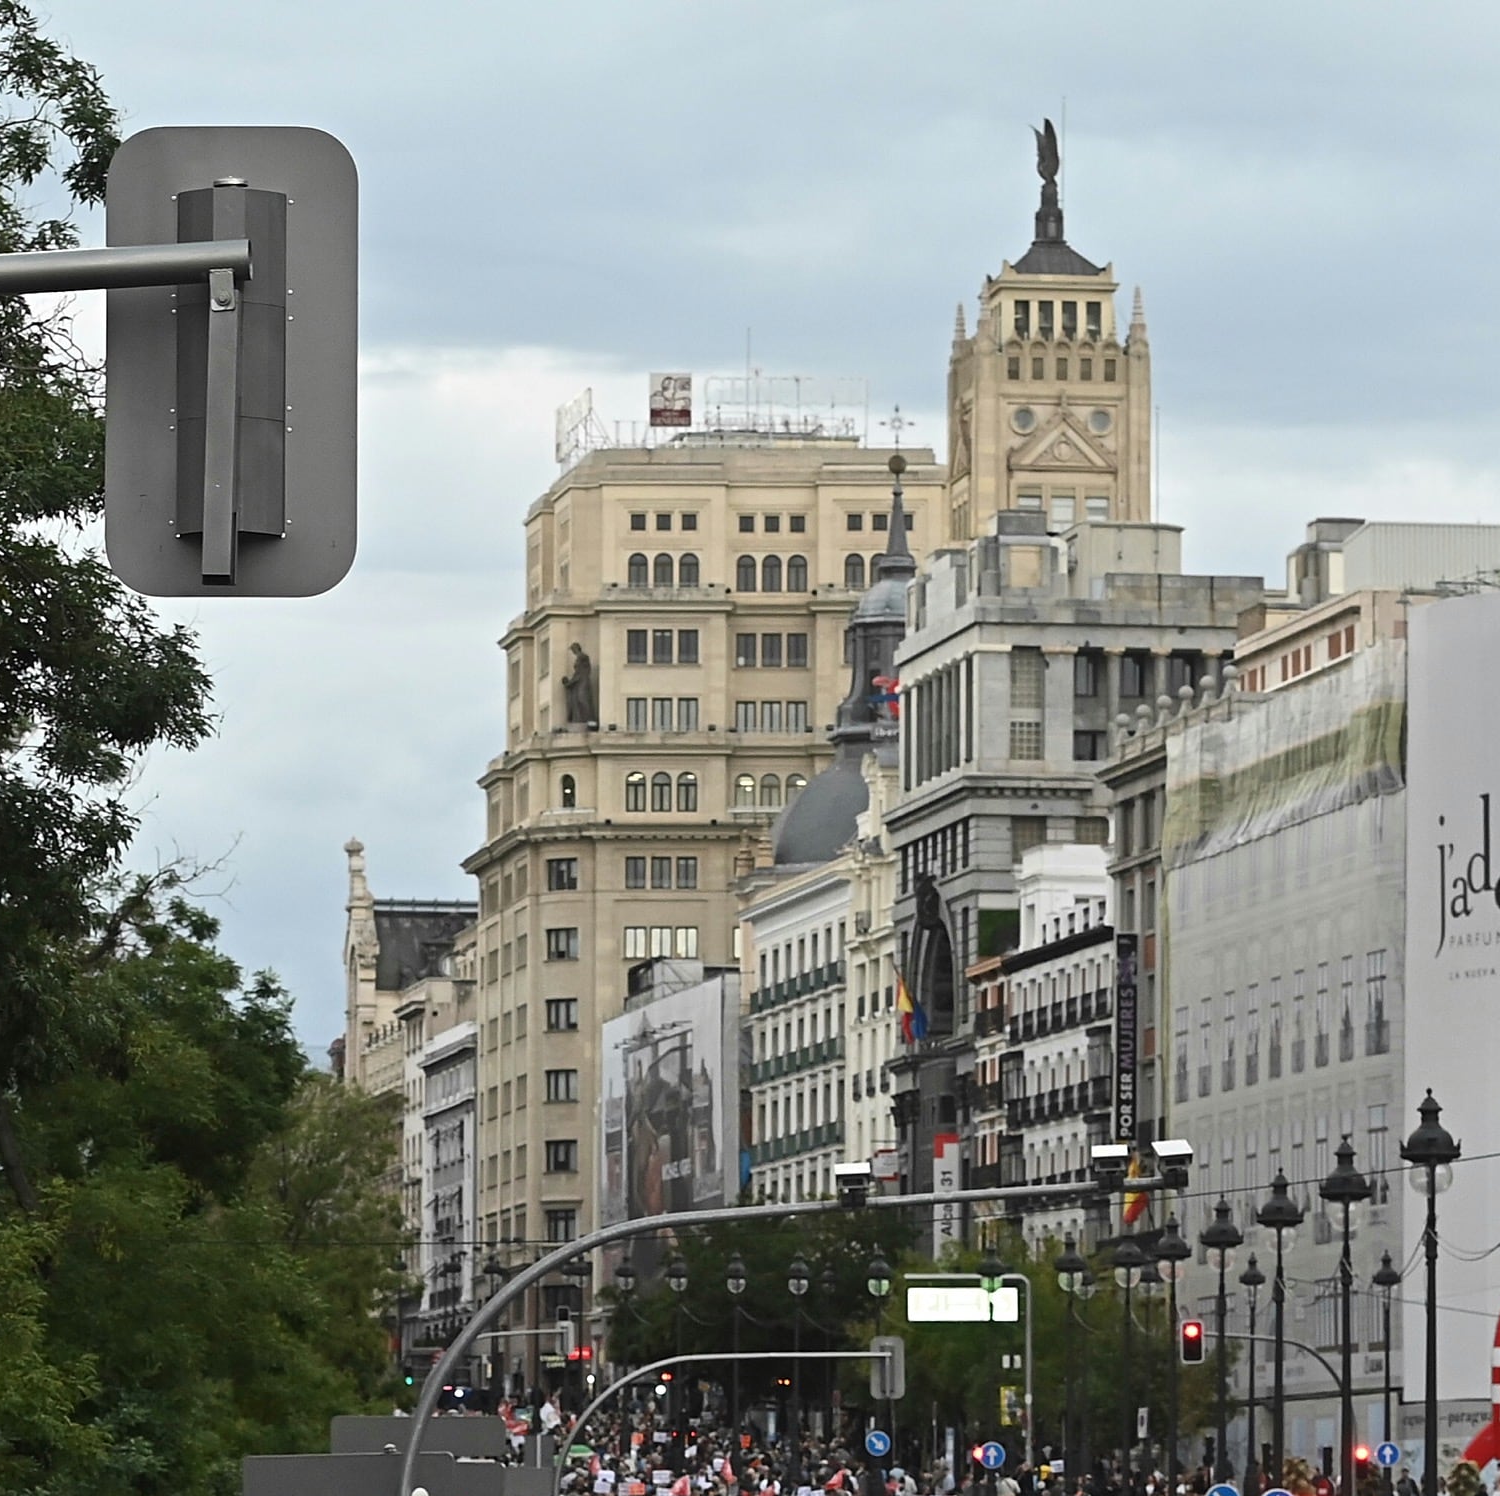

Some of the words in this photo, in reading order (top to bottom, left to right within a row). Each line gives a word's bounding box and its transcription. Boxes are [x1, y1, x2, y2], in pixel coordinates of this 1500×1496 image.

[1119, 988, 1133, 1069] MUJERES
[1119, 1072, 1133, 1102] SER
[1119, 1105, 1133, 1137] POR
